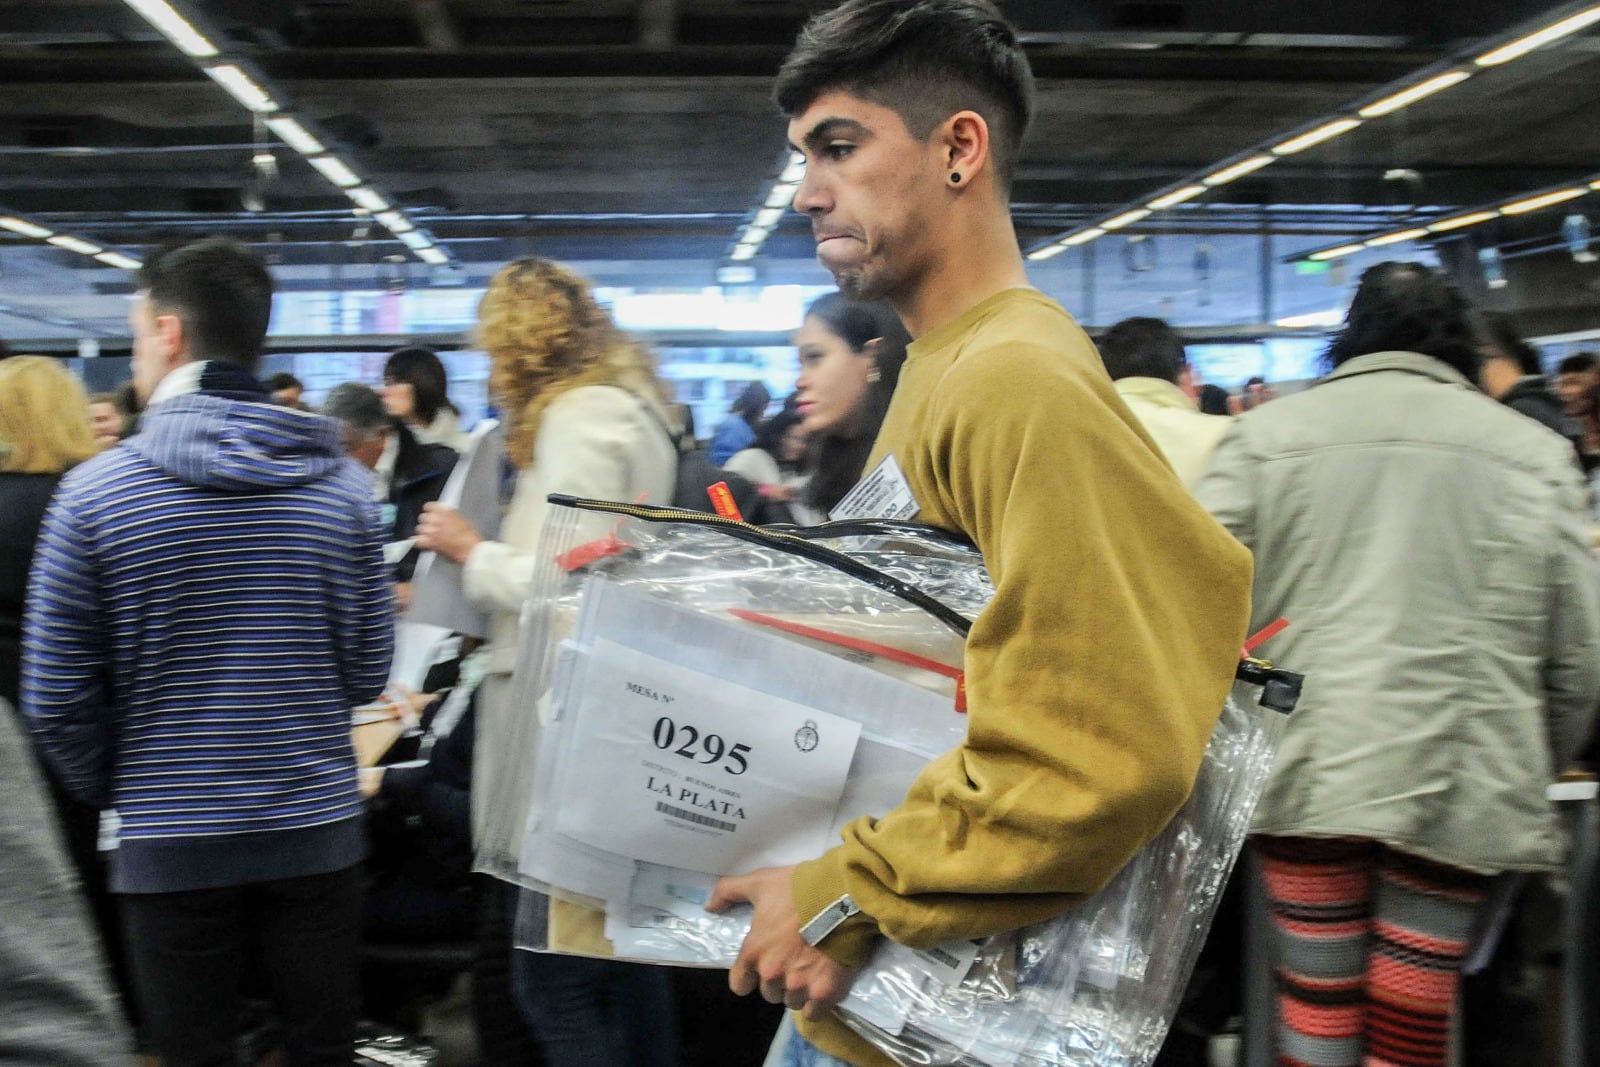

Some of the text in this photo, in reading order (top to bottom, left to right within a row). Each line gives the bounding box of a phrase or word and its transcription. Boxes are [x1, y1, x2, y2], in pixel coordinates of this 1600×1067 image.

[626, 682, 658, 700] MESA
[654, 717, 752, 775] 0295
[647, 776, 746, 819] LA PLATA
